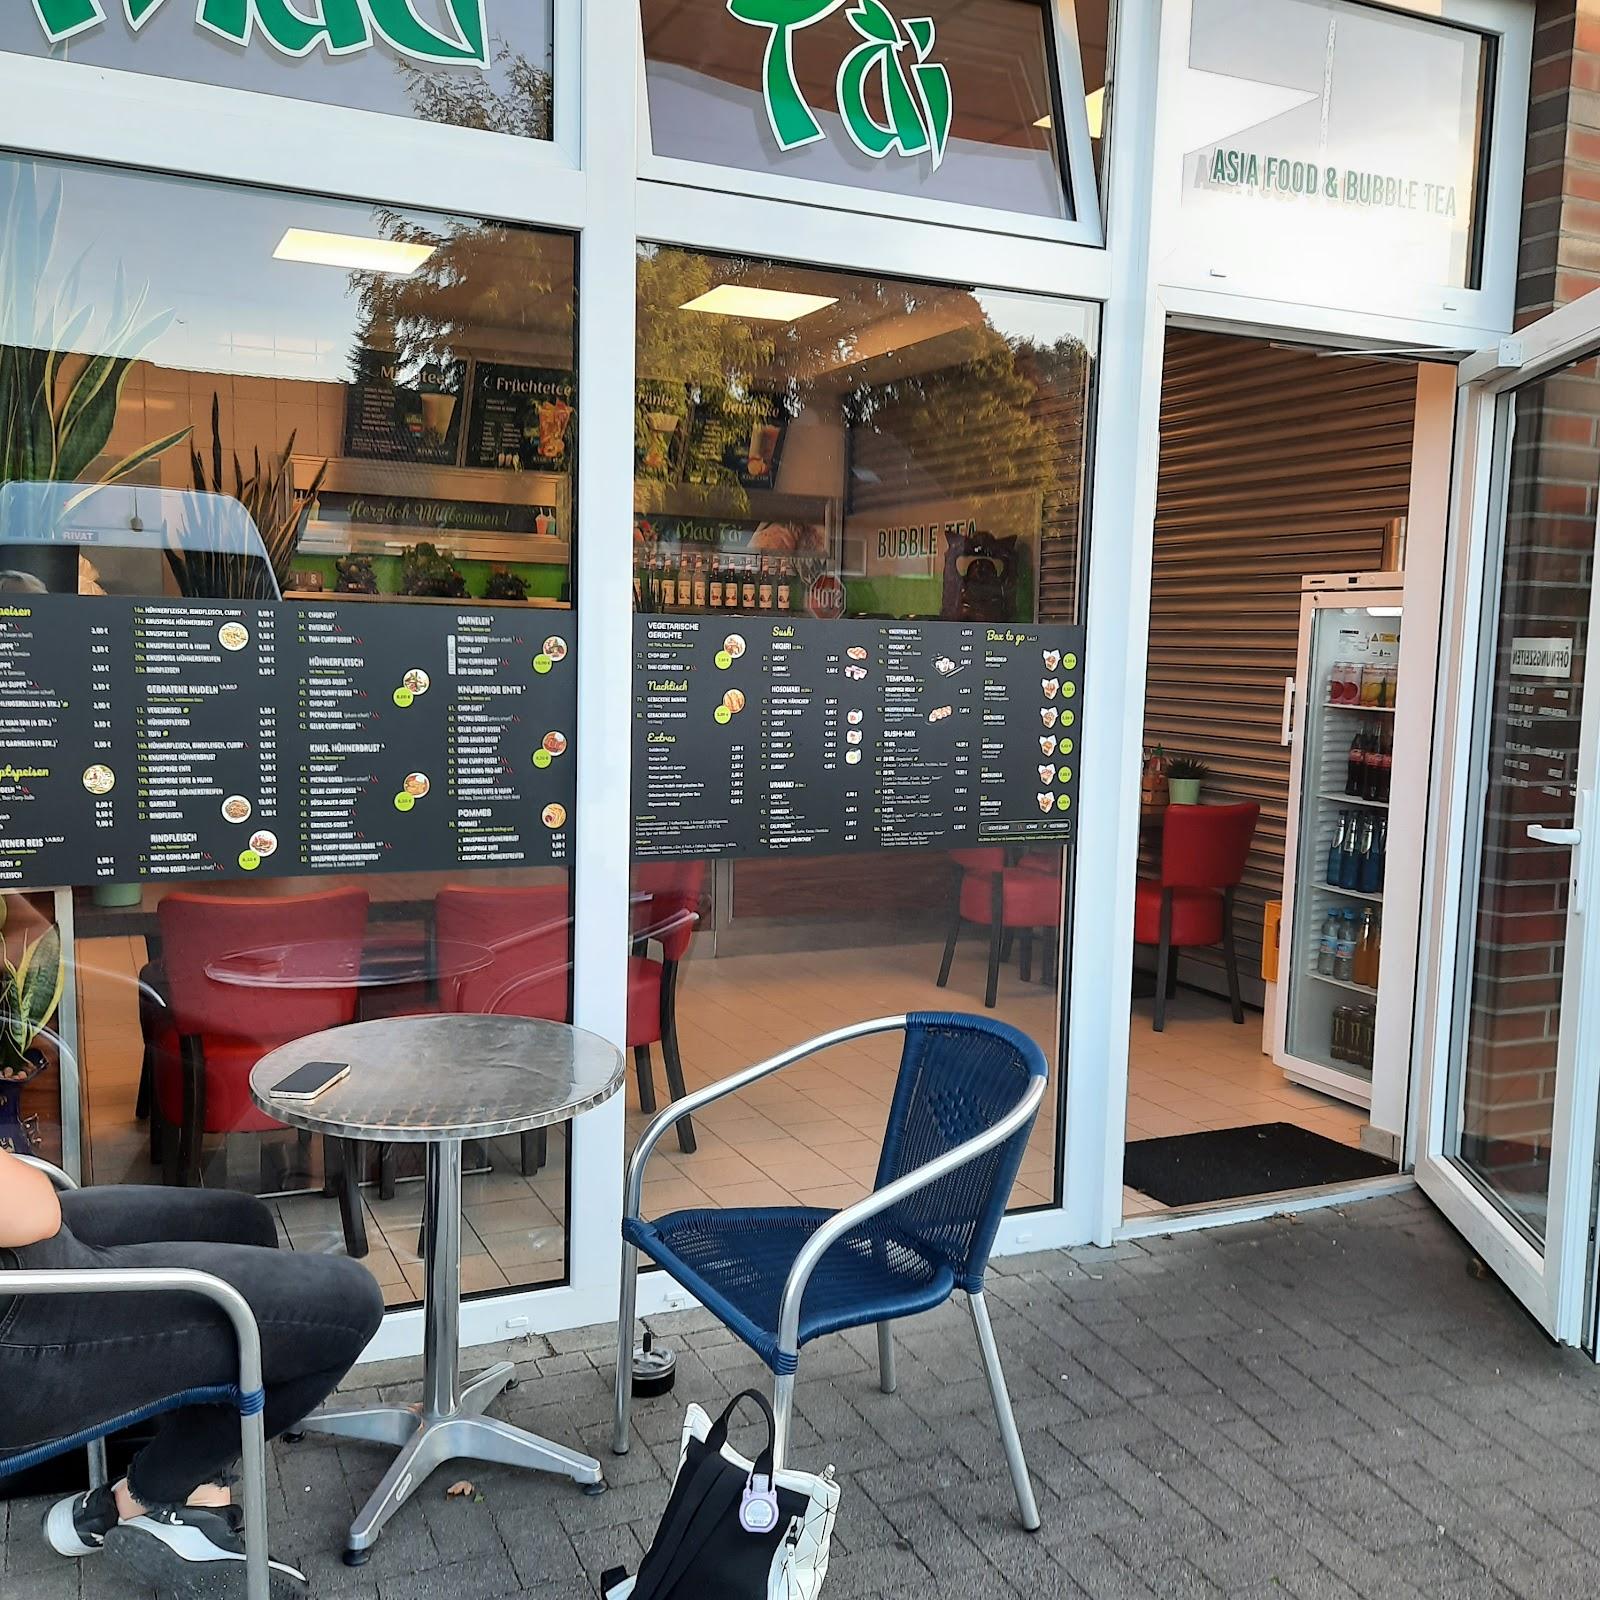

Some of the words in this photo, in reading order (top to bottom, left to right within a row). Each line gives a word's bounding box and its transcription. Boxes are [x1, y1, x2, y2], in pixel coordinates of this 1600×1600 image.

[1212, 149, 1258, 186] ASIA
[1265, 157, 1318, 195] FOOD
[1325, 167, 1339, 198] &
[1345, 170, 1418, 210] BUBBLE
[1424, 183, 1457, 217] TEA
[347, 500, 411, 523] Herzlich
[414, 503, 500, 527] Willkommen
[877, 523, 938, 560] BUBBLE
[457, 616, 491, 626] GARNELEN
[647, 621, 700, 631] VEGETARISCHE
[647, 631, 683, 640] GERICHTE
[772, 626, 795, 637] Sushi
[986, 629, 1005, 641] Box
[1005, 629, 1015, 640] to
[1015, 633, 1026, 646] go
[308, 656, 364, 667] HÜHNERFLEISCH
[885, 675, 915, 683] TEMPURA
[146, 685, 188, 694] GEBRATENE
[189, 686, 219, 695] NUDELN
[457, 685, 501, 695] KNUSPRIGE
[502, 686, 522, 694] ENTE
[647, 680, 688, 692] Nachtisch
[647, 732, 676, 743] Extras
[883, 730, 916, 738] SUSHI-MIX
[332, 743, 380, 753] HÜHNERBRUST
[457, 808, 492, 818] POMMES
[150, 833, 198, 843] RINDFLEISCH
